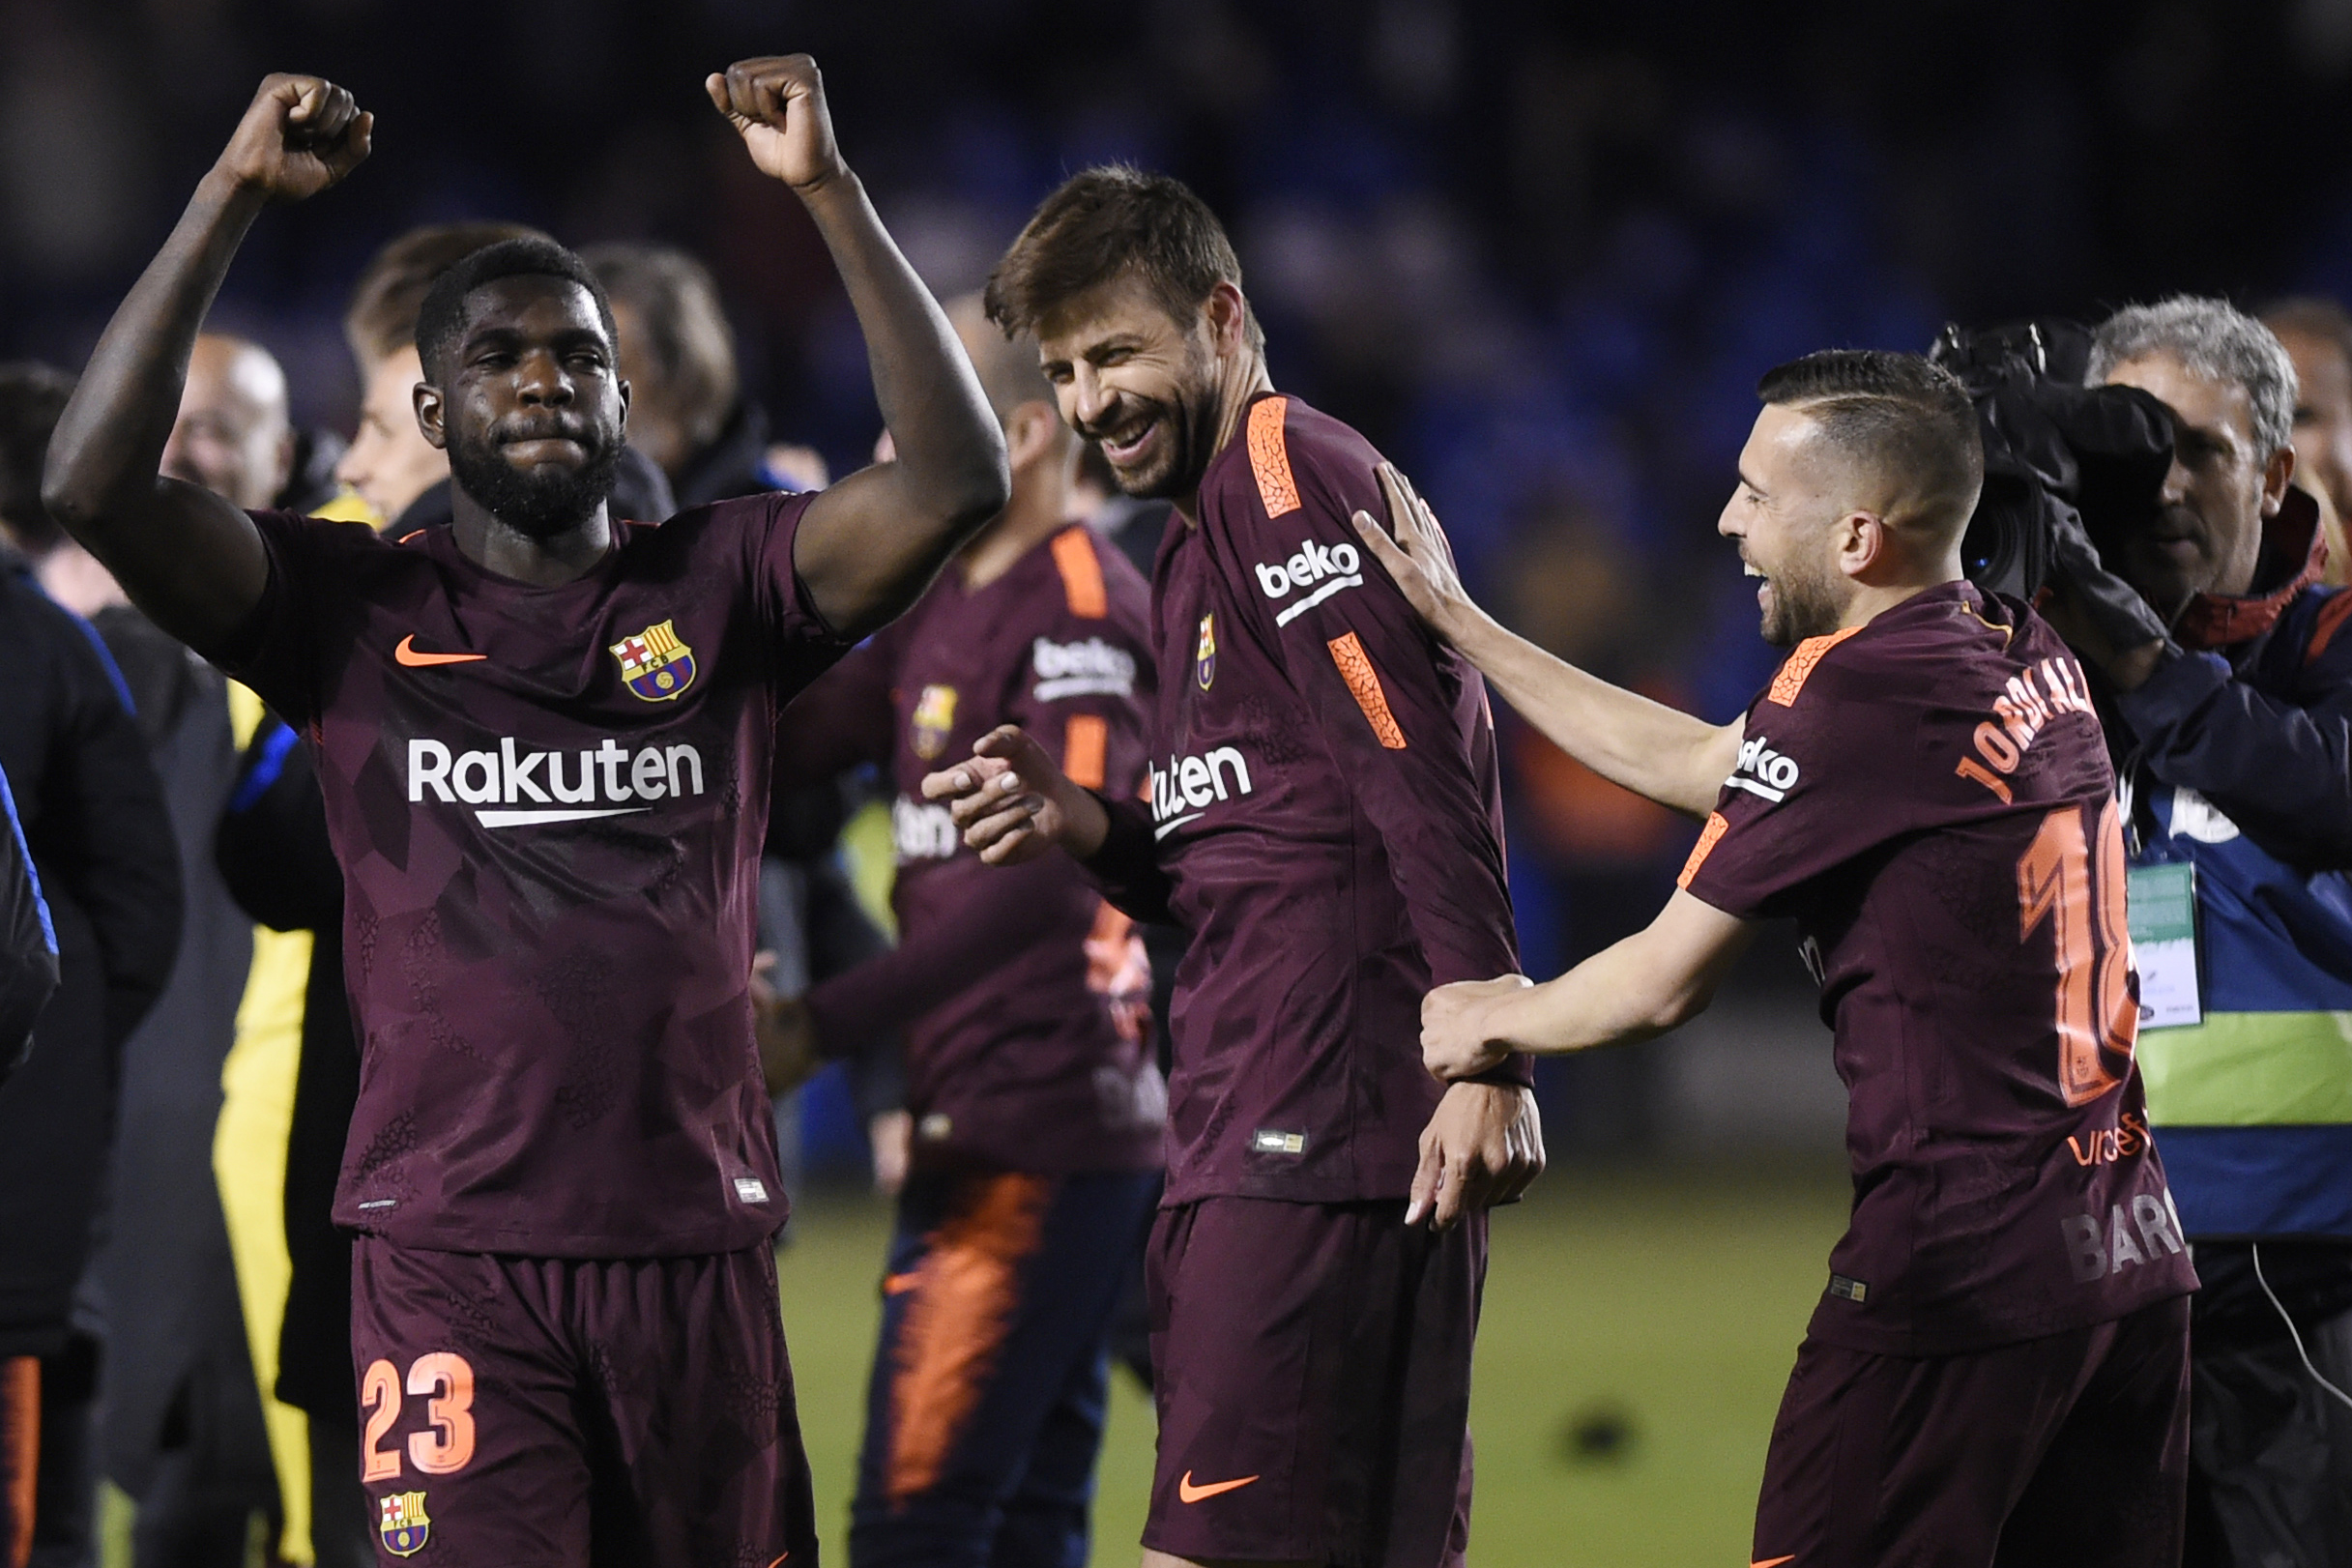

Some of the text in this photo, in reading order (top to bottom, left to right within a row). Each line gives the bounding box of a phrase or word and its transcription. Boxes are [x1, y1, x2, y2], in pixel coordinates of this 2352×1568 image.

[1255, 539, 1361, 598] beko
[1034, 637, 1137, 680] beko
[1737, 736, 1799, 790] eko
[1955, 667, 2055, 806] JORDI
[408, 737, 704, 804] Rakuten
[362, 1351, 477, 1484] 23
